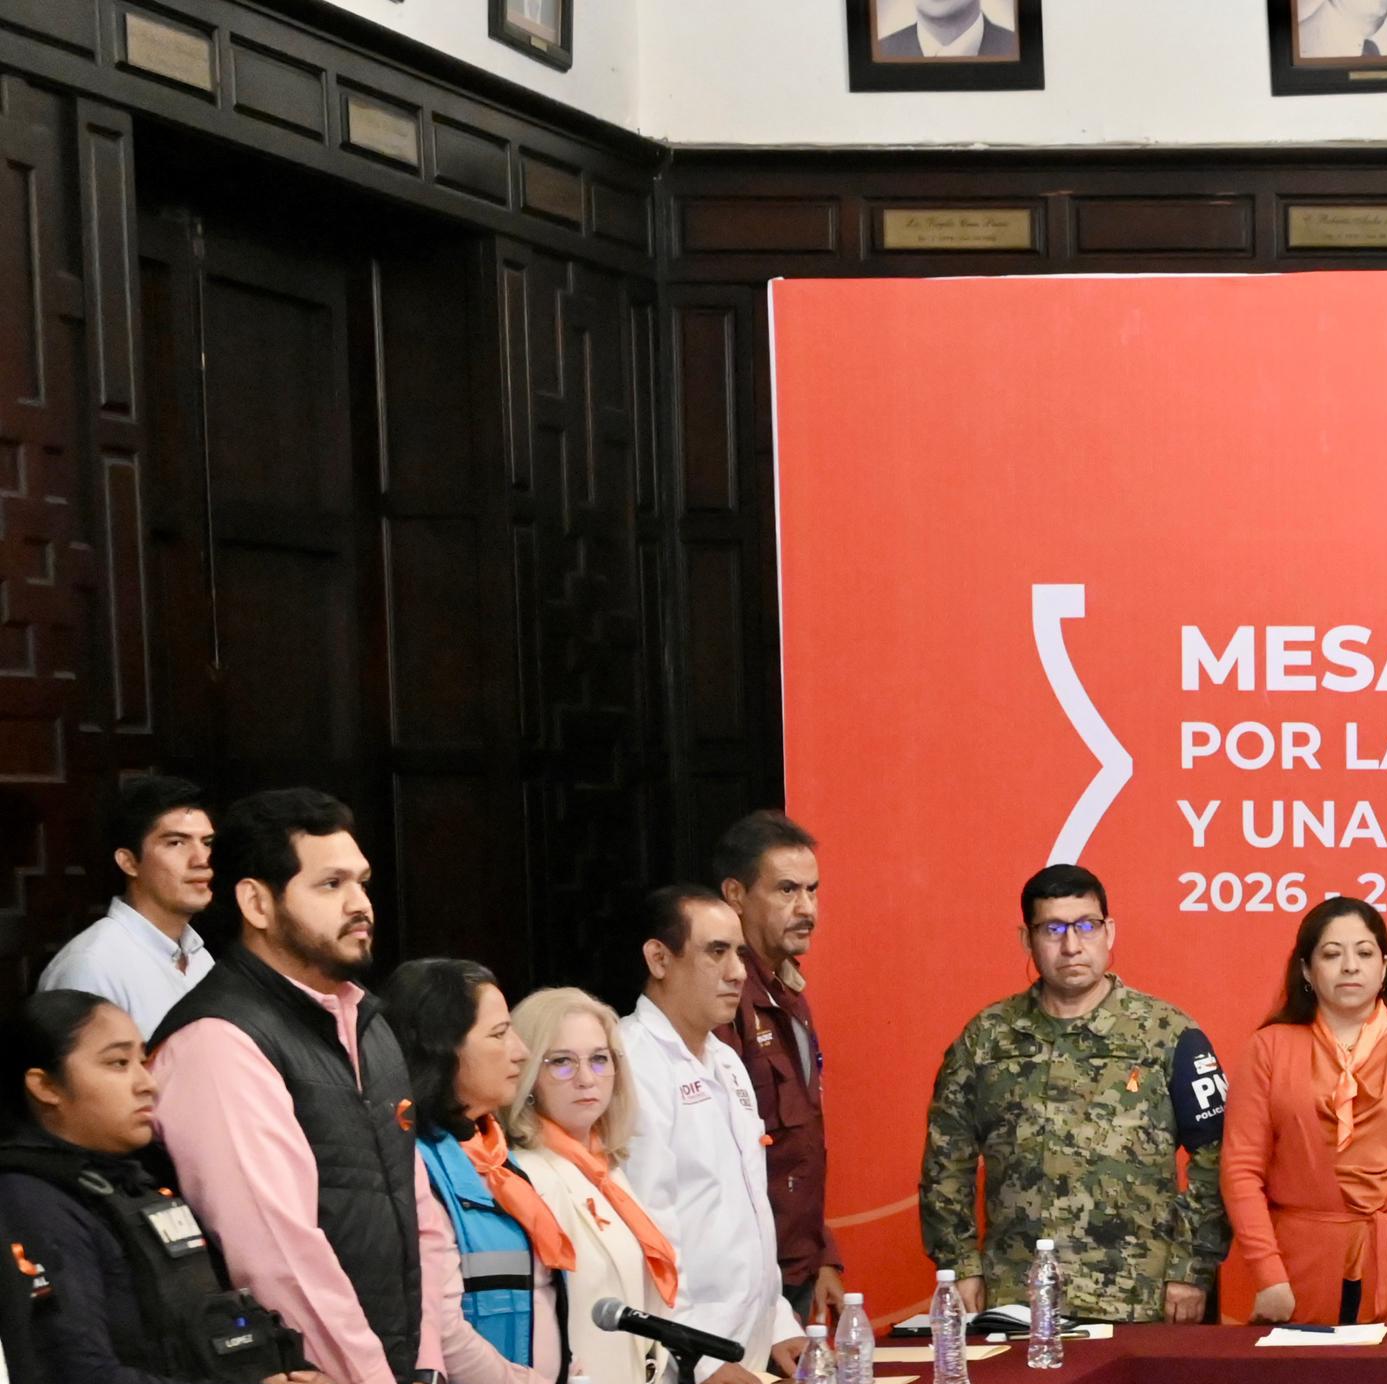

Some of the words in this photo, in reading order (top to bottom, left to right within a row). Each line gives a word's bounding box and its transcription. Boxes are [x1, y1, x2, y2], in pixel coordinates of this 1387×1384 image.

[1182, 721, 1323, 772] POR
[1177, 800, 1222, 849] Y
[1178, 872, 1310, 914] 2026
[682, 1080, 702, 1096] DIF
[1195, 1105, 1225, 1122] POLICI
